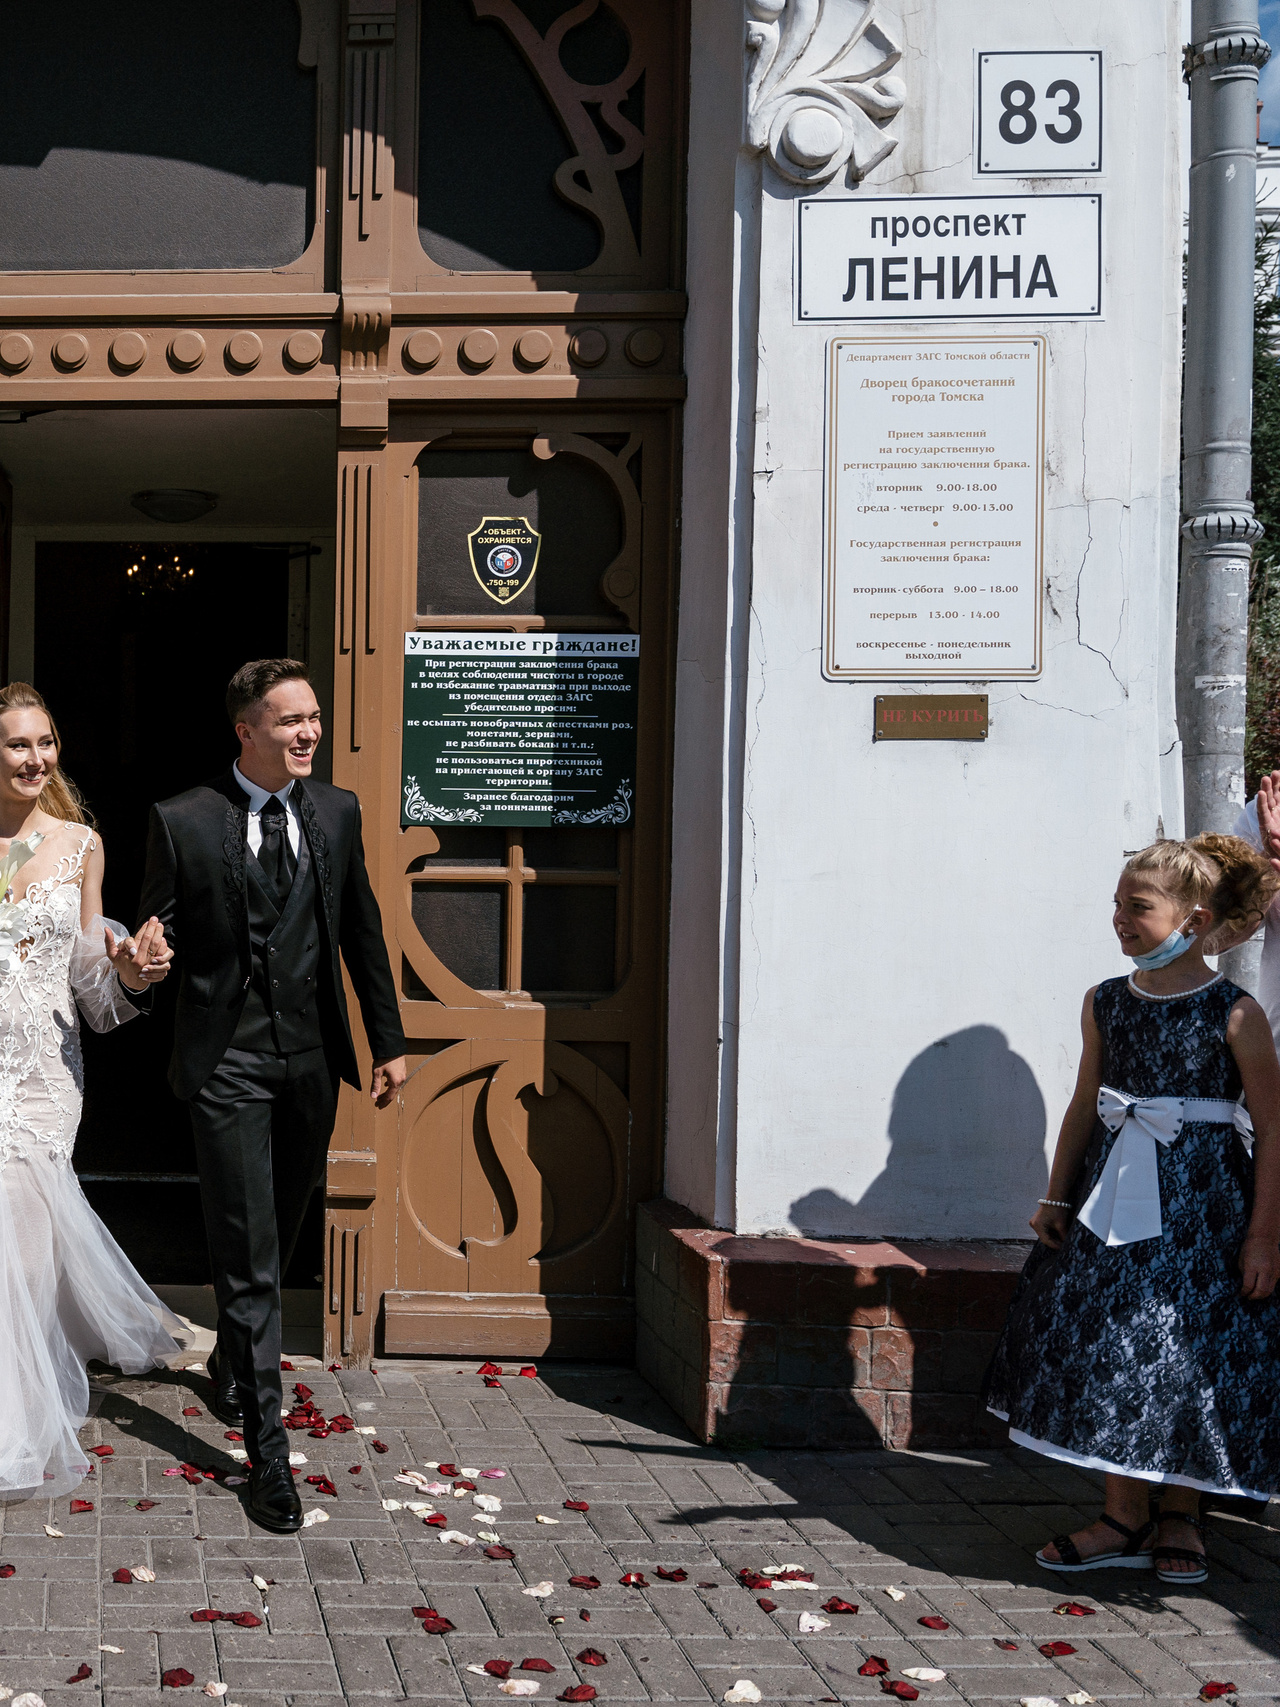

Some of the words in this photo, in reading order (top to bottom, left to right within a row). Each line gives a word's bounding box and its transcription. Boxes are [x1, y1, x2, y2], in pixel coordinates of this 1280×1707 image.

[999, 79, 1083, 145] 83
[871, 213, 1026, 246] проспект
[842, 255, 1058, 303] ЛЕНИНА
[846, 352, 912, 363] Департамент
[916, 352, 942, 361] ЗАГС
[945, 352, 987, 361] Томской
[990, 351, 1031, 360] области
[860, 378, 908, 390] Дворец
[911, 376, 1016, 388] бракосочетаний
[892, 393, 935, 404] города
[939, 392, 984, 402] Томска
[888, 430, 924, 439] Прием
[927, 429, 986, 438] заявлений
[879, 446, 893, 454] на
[896, 445, 995, 455] государственную
[843, 461, 917, 471] регистрацию
[921, 461, 990, 469] заключения
[994, 459, 1031, 469] брака.
[876, 485, 923, 493] вторник
[936, 484, 997, 492] 9.00-18.00
[857, 505, 890, 513] среда
[900, 505, 945, 514] четверг
[953, 503, 1014, 512] 9.00-13.00
[850, 539, 946, 549] Государственная
[950, 539, 1022, 548] регистрация
[880, 554, 950, 563] заключения
[953, 554, 990, 562] брака:
[954, 585, 977, 594] 9.00
[990, 585, 1018, 594] 18.00
[870, 611, 918, 620] перерыв
[929, 611, 959, 619] 13.00
[970, 611, 1000, 619] 14.00
[409, 637, 526, 650] Уважаемые
[532, 639, 637, 654] граждане!
[856, 641, 926, 649] воскресенье
[937, 640, 1011, 649] понедельник
[905, 651, 962, 660] выходной
[425, 660, 446, 669] При
[449, 660, 516, 669] регистрации
[519, 661, 584, 669] заключения
[587, 661, 618, 669] брака
[463, 670, 527, 680] соблюдения
[530, 672, 574, 680] чистоты
[587, 673, 623, 681] городе
[437, 681, 495, 689] избежание
[569, 684, 588, 692] при
[592, 684, 631, 692] выходе
[464, 694, 524, 702] помещения
[528, 694, 563, 702] отдела
[566, 693, 593, 701] ЗАГС
[464, 703, 531, 713] убедительно
[534, 705, 576, 713] просим:
[883, 710, 906, 722] НЕ
[912, 710, 984, 722] КУРИТЬ
[470, 720, 543, 728] новобрачных
[612, 723, 633, 731] роз,
[467, 731, 522, 739] монетами,
[461, 740, 516, 748] разбивать
[519, 740, 559, 748] бокалы
[527, 757, 602, 767] пиротехникой
[451, 767, 524, 776] прилегающей
[536, 769, 572, 777] органу
[576, 768, 603, 776] ЗАГС
[485, 778, 552, 787] территории.
[463, 793, 508, 801] Заранее
[510, 793, 574, 802] благодарим
